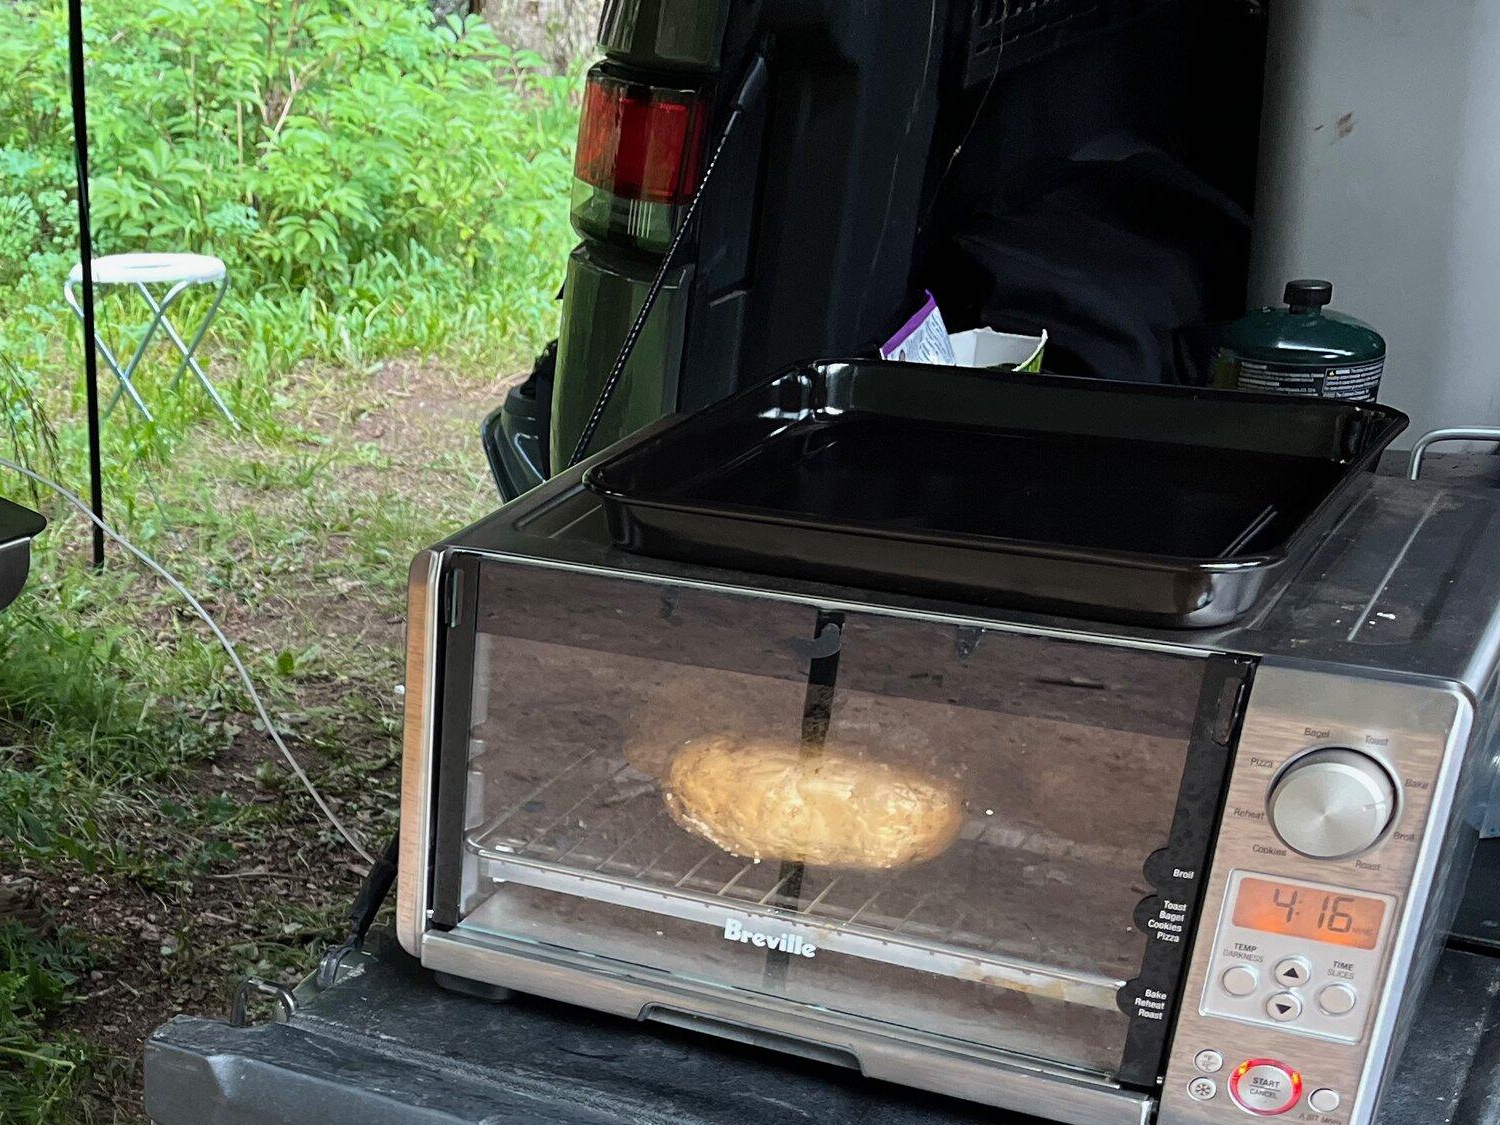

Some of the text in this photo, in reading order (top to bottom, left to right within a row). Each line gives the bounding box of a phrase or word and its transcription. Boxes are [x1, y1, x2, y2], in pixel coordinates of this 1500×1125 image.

[1250, 757, 1273, 769] Pizza
[1233, 807, 1266, 820] Reheat
[1173, 868, 1195, 880] Broil
[1164, 900, 1187, 912] Toast
[1273, 888, 1355, 933] 4:16
[1159, 910, 1185, 923] Bagel
[1148, 919, 1183, 933] Cookies
[724, 918, 817, 958] Breville
[1156, 931, 1180, 943] Pizza
[1233, 942, 1258, 952] TEMP
[1222, 949, 1264, 963] DARKNESS
[1332, 960, 1354, 972] TIME
[1326, 968, 1355, 980] SLICES
[1144, 988, 1167, 1000] Bake
[1134, 997, 1165, 1010] Reheat
[1138, 1008, 1163, 1020] Roast
[1252, 1077, 1281, 1088] START
[1249, 1088, 1278, 1100] CANCEL
